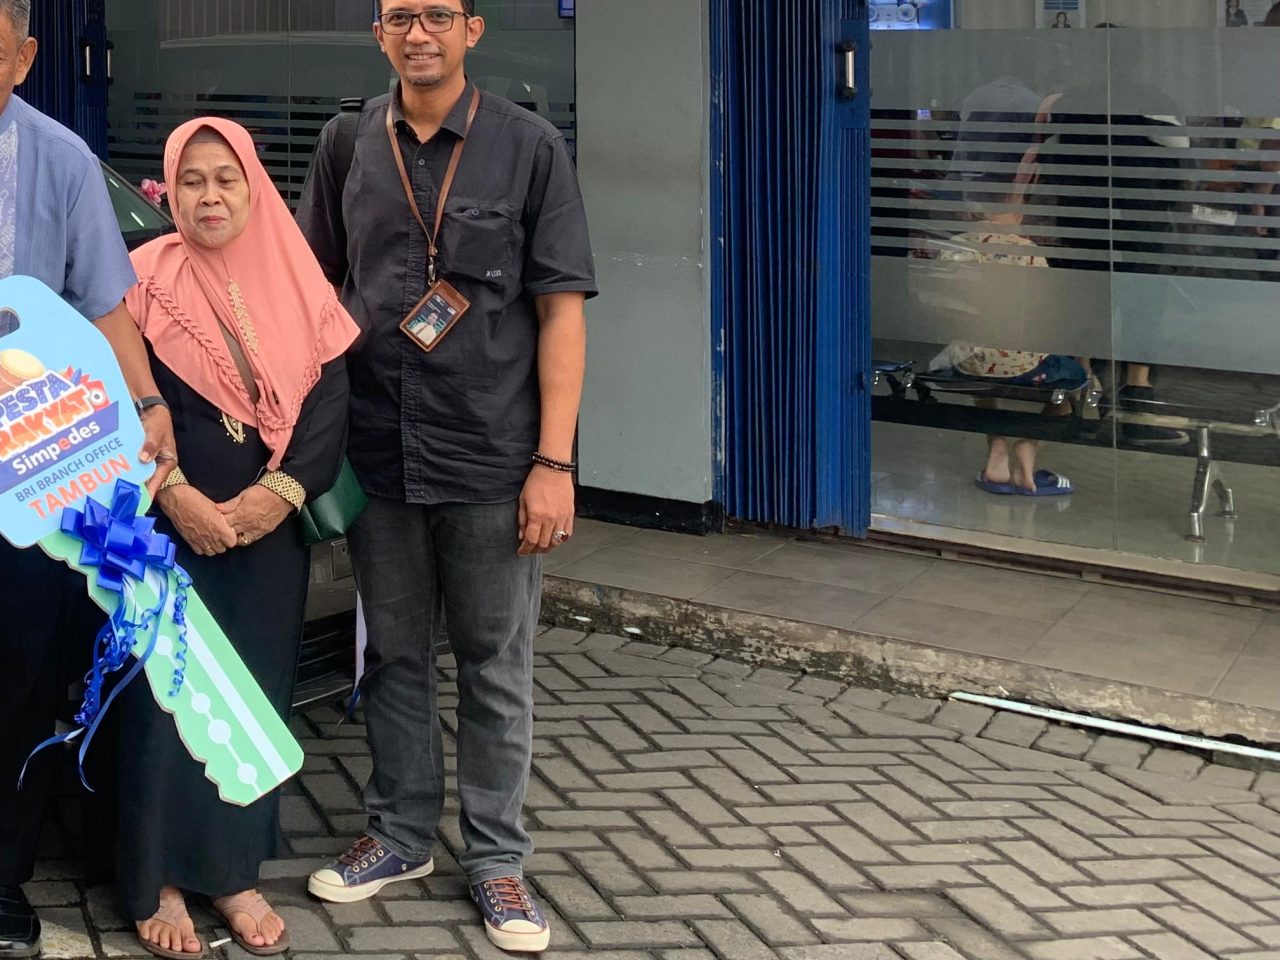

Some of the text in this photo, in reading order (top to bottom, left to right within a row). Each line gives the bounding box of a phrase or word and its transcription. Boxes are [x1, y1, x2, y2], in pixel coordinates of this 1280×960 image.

[12, 421, 101, 476] Simpedes
[15, 437, 124, 502] BRI BRANCH OFFICE
[28, 453, 132, 520] TAMBUN
